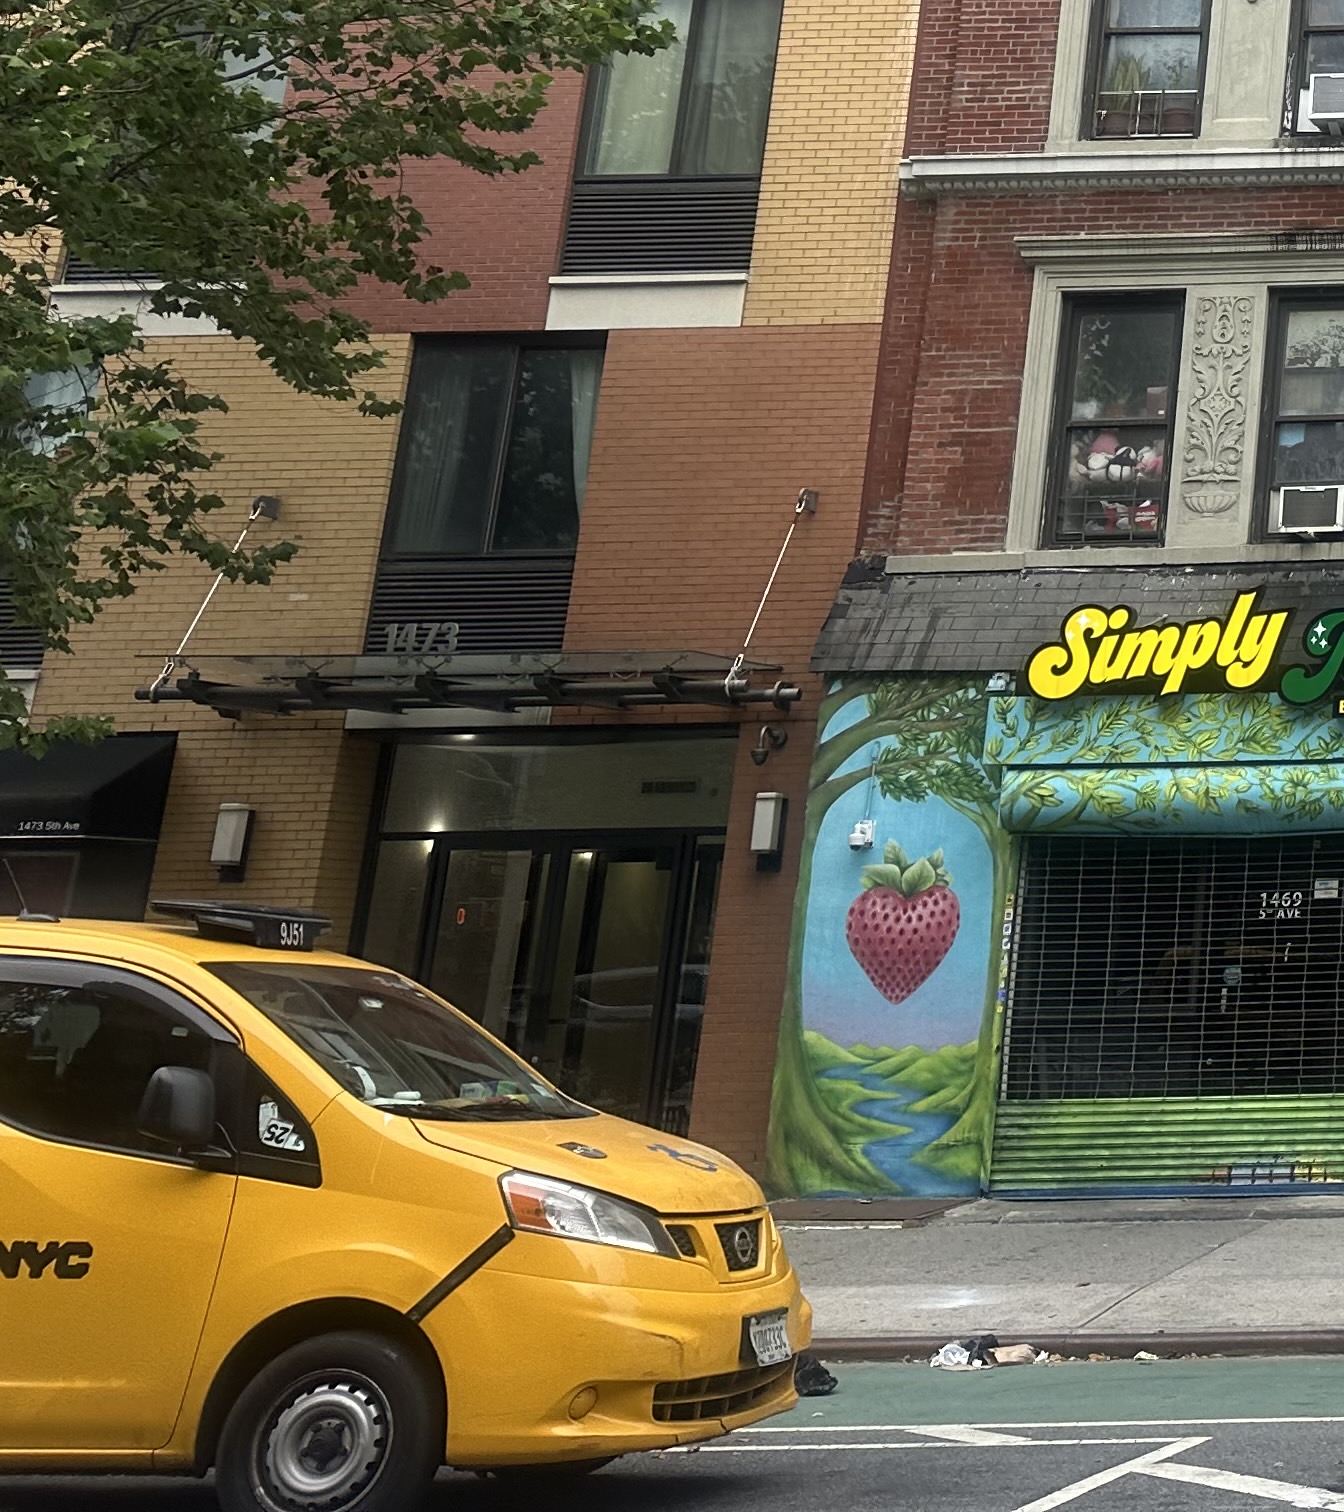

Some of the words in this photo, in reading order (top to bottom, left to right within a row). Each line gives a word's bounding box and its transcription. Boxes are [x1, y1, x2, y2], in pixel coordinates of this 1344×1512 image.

[384, 622, 459, 655] 1473
[1028, 591, 1288, 700] Simply
[18, 821, 44, 831] 1473
[45, 821, 61, 830] 5th
[62, 821, 80, 830] Ave
[1260, 891, 1303, 907] 1469
[1276, 908, 1301, 919] AVE
[280, 922, 304, 945] 9J51
[0, 1240, 93, 1279] NYC
